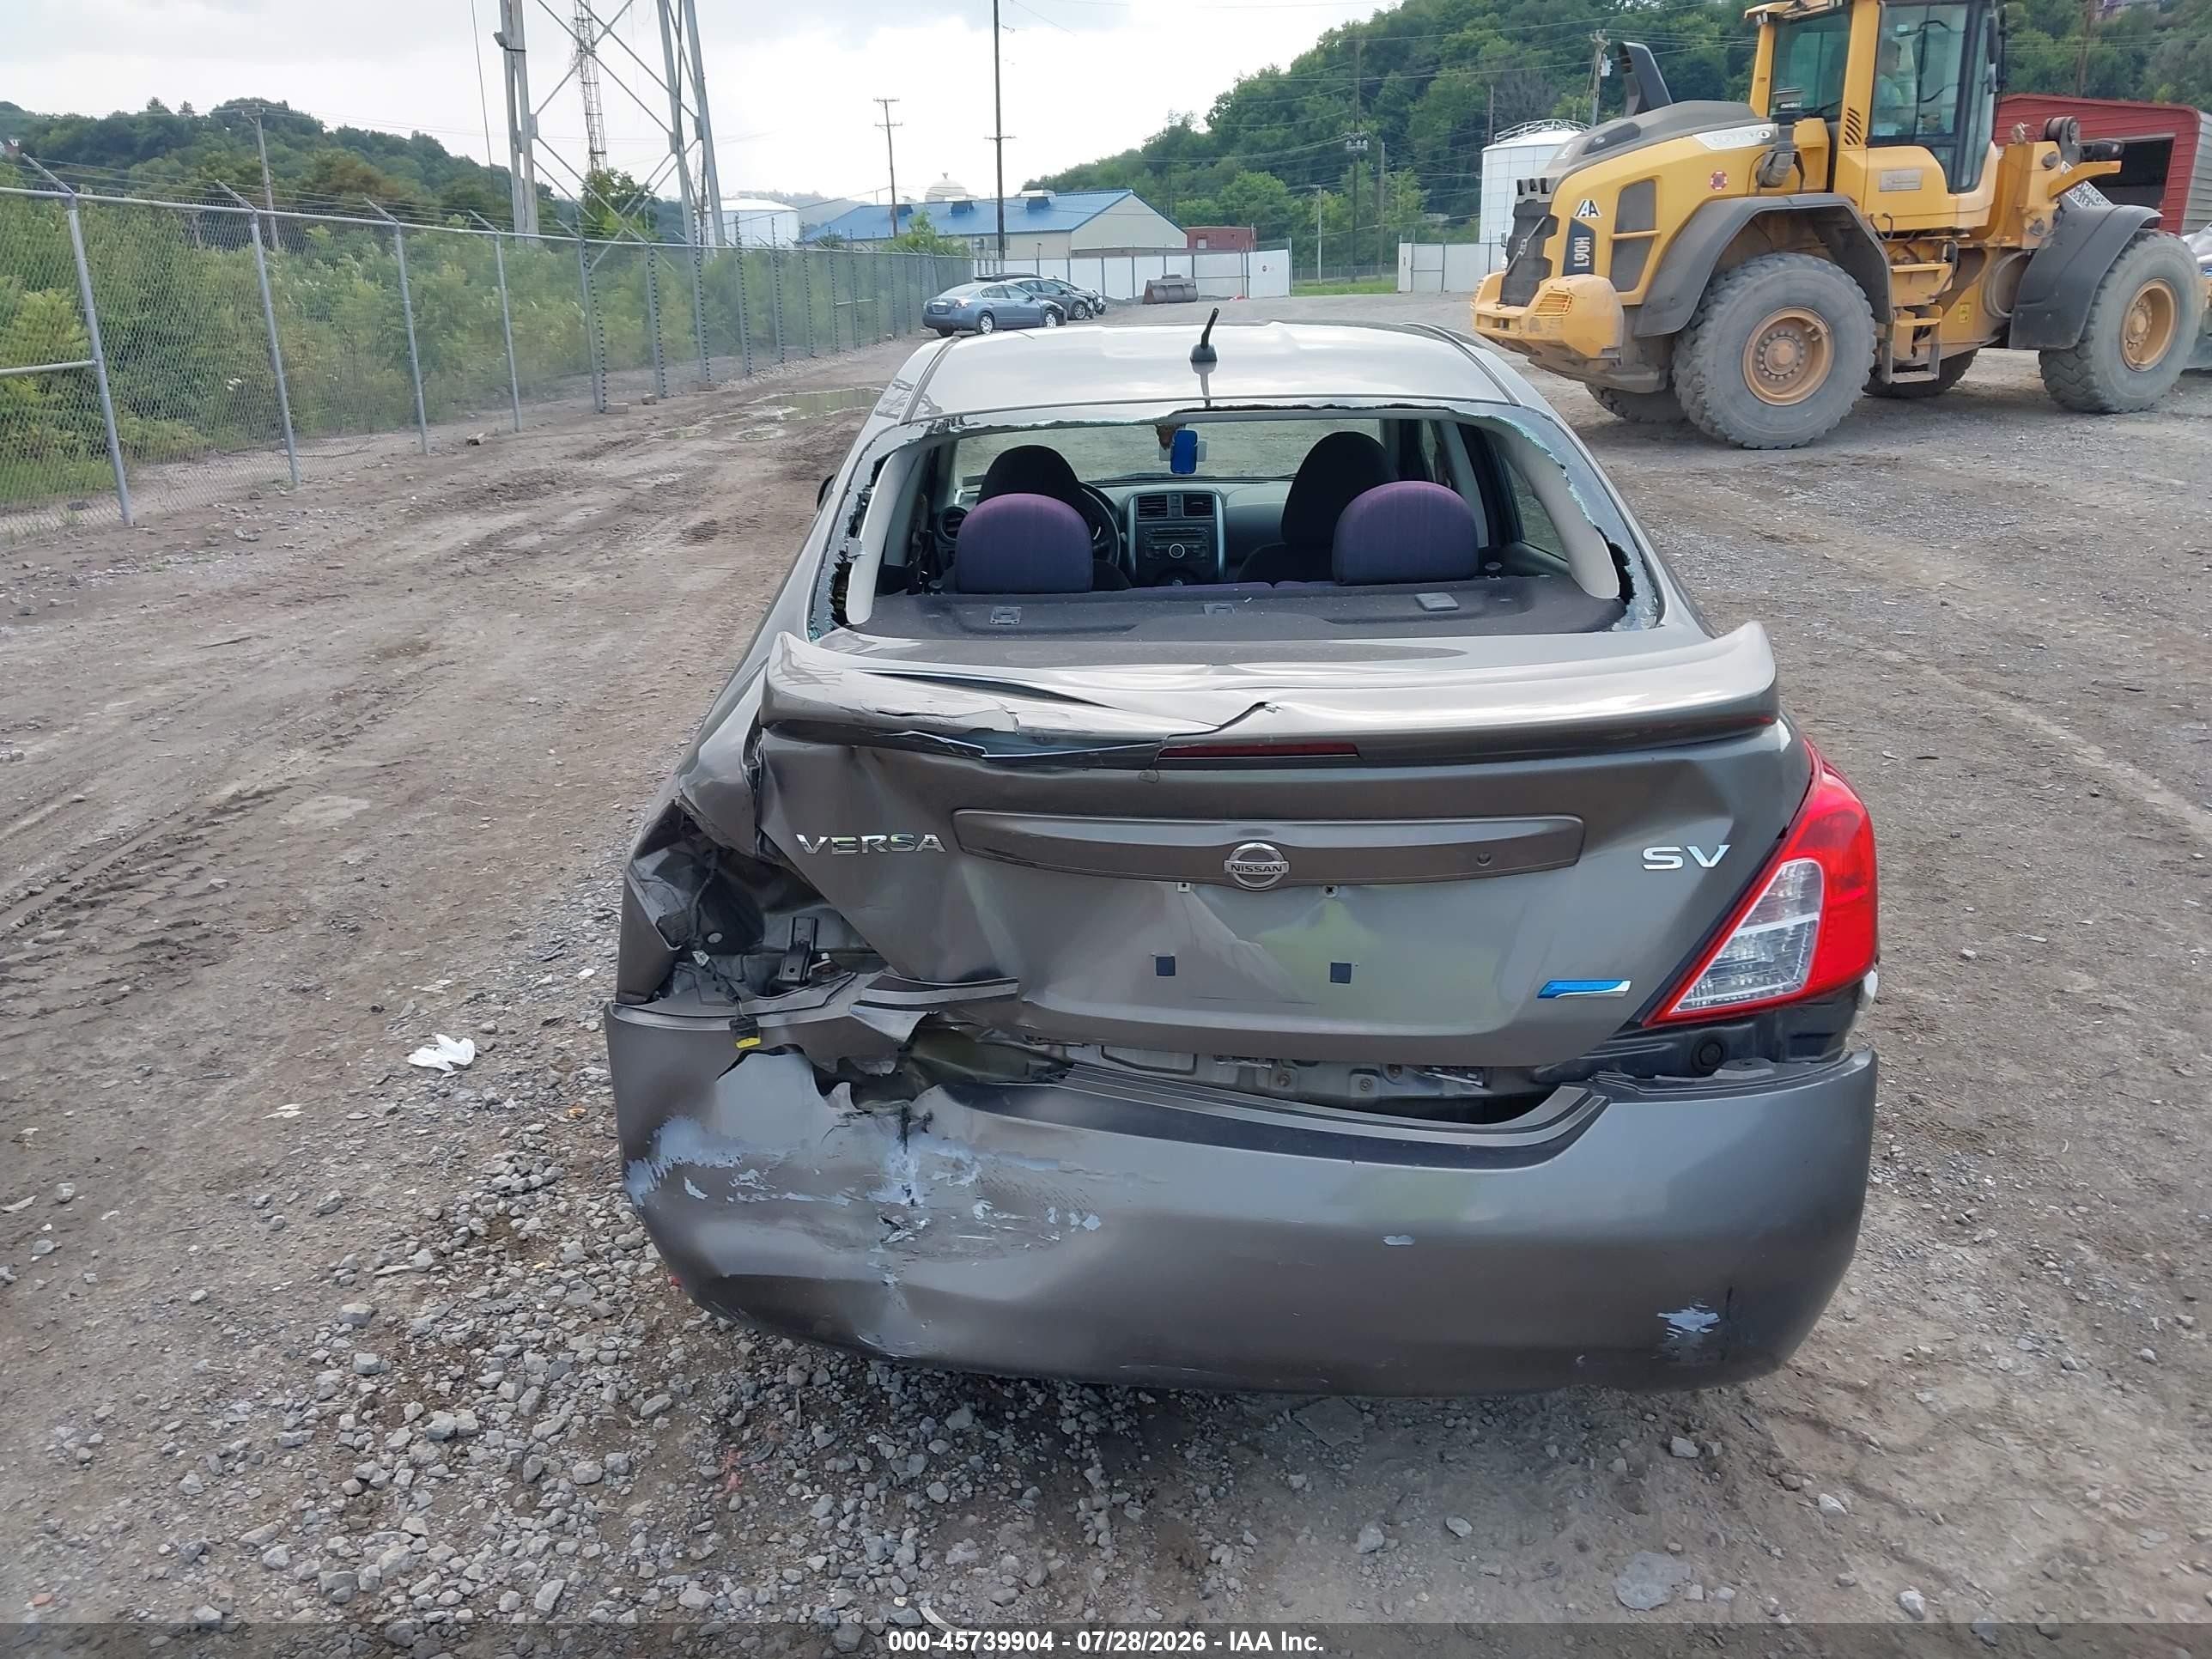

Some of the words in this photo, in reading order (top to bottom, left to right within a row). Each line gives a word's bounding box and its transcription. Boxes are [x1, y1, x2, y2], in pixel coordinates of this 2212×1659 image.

[1573, 236, 1591, 267] L90H
[796, 834, 946, 854] VERSA
[1643, 845, 1731, 870] SV
